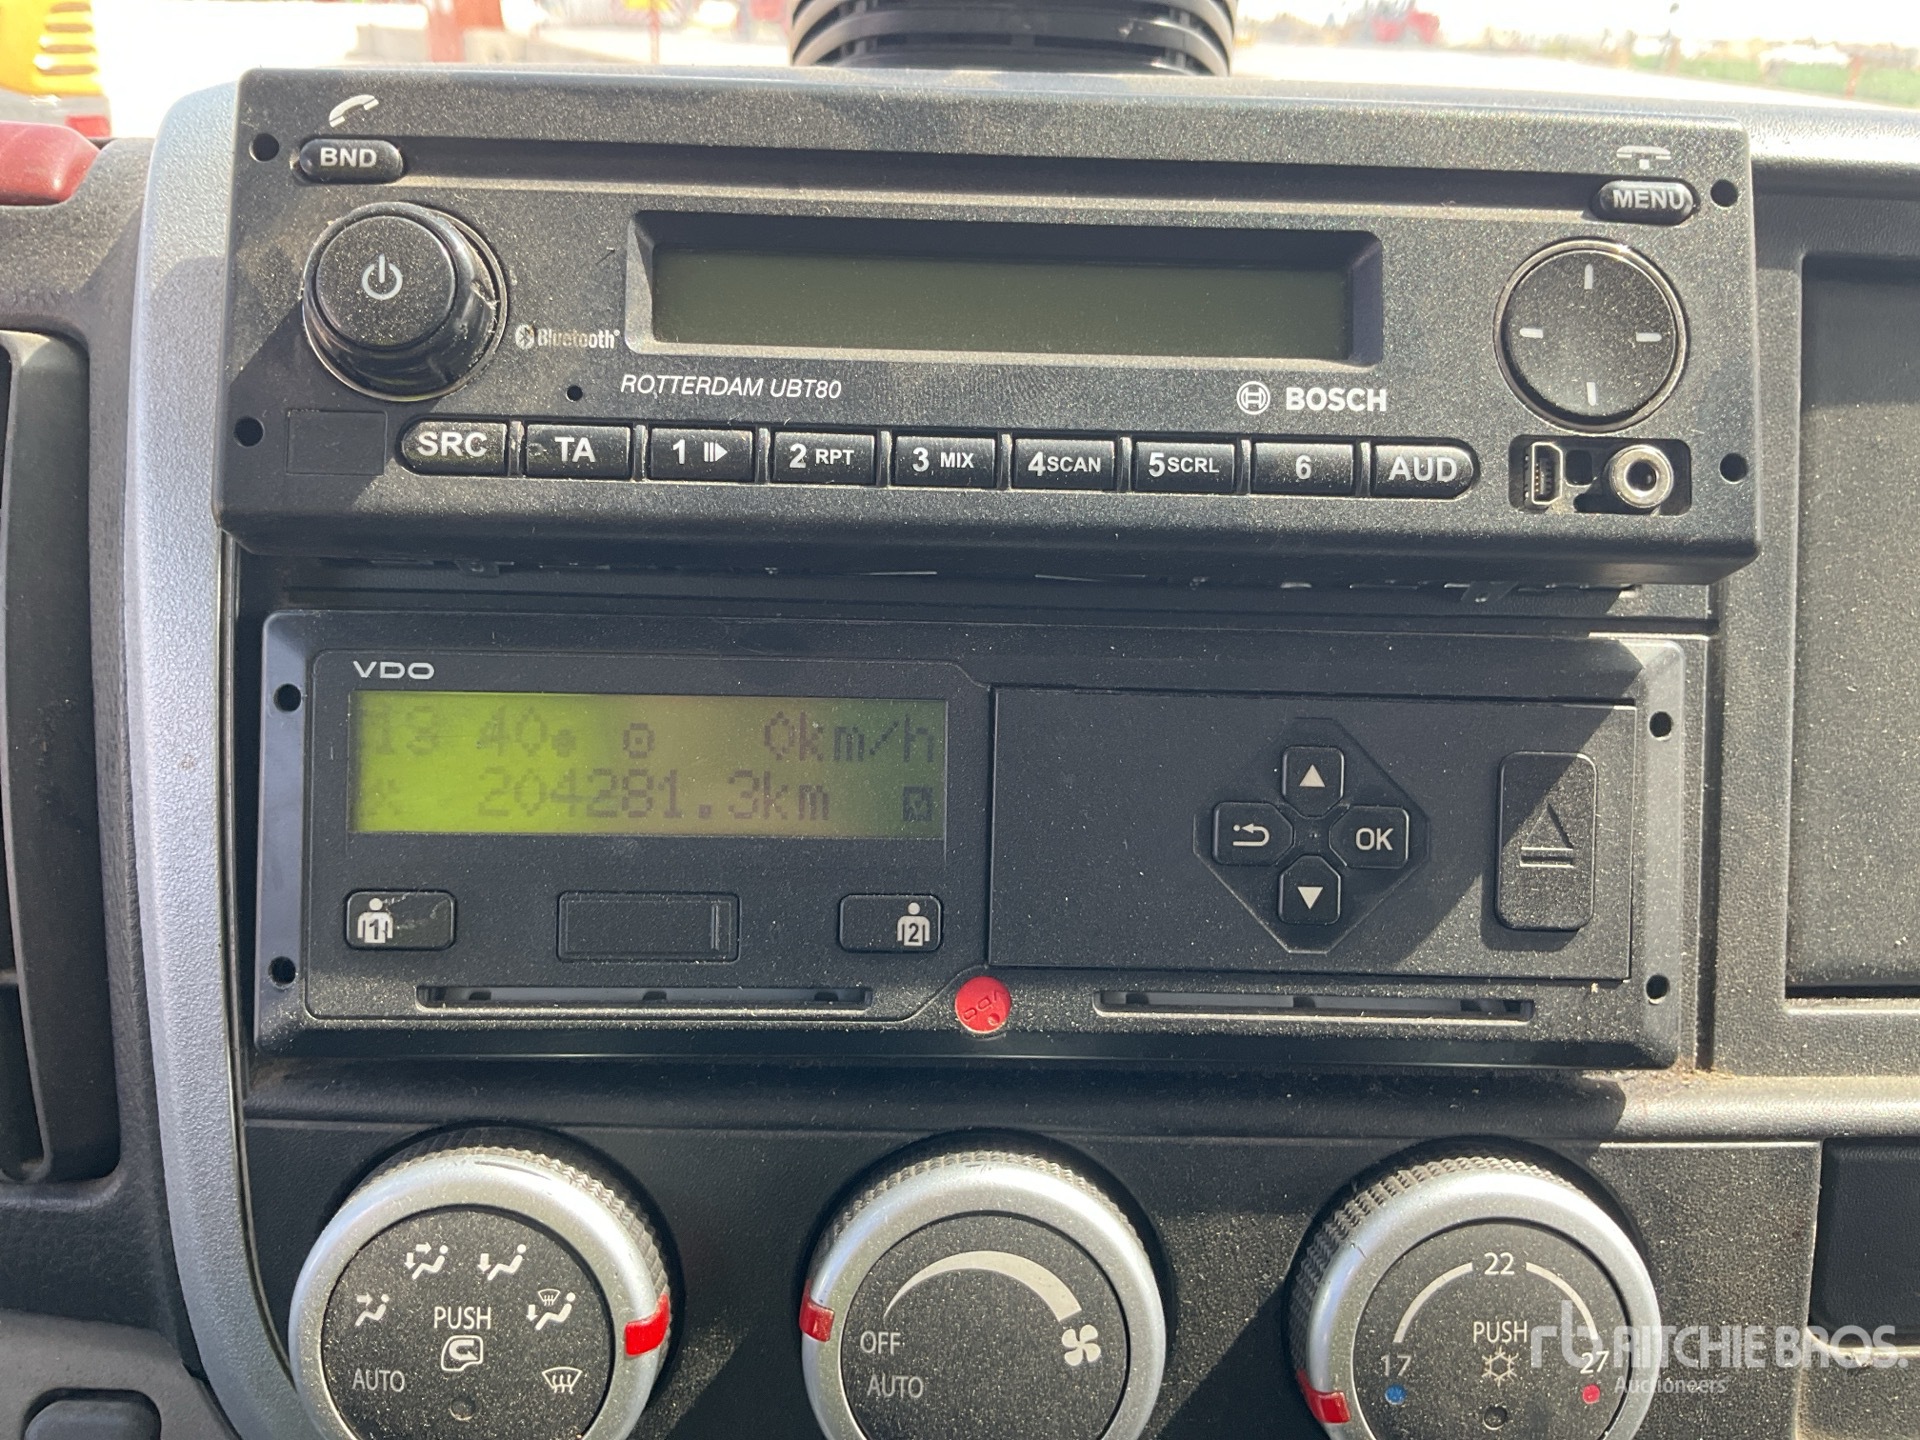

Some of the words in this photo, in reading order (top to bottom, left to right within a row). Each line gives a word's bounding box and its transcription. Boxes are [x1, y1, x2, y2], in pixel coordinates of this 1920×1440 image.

[319, 146, 378, 169] BND
[1612, 186, 1685, 211] MENU
[620, 374, 764, 397] ROTTERDAM
[769, 378, 842, 400] UBT80
[1285, 387, 1388, 412] BOSCH
[417, 430, 488, 458] SRC
[554, 435, 596, 463] TA
[672, 438, 687, 465] 1
[789, 443, 807, 469] 2
[815, 449, 855, 465] RPT
[912, 447, 930, 472] 3
[940, 452, 975, 469] MIX
[1295, 458, 1312, 480] 6
[1388, 454, 1459, 482] AUD
[353, 661, 435, 680] VDO
[1355, 827, 1394, 852] OK
[1484, 1252, 1515, 1276] 22
[433, 1306, 492, 1331] PUSH
[860, 1331, 902, 1356] OFF
[1472, 1320, 1529, 1344] PUSH
[1380, 1355, 1413, 1377] 17
[1579, 1350, 1610, 1375] 27
[352, 1367, 406, 1393] AUTO
[866, 1373, 925, 1400] AUTO
